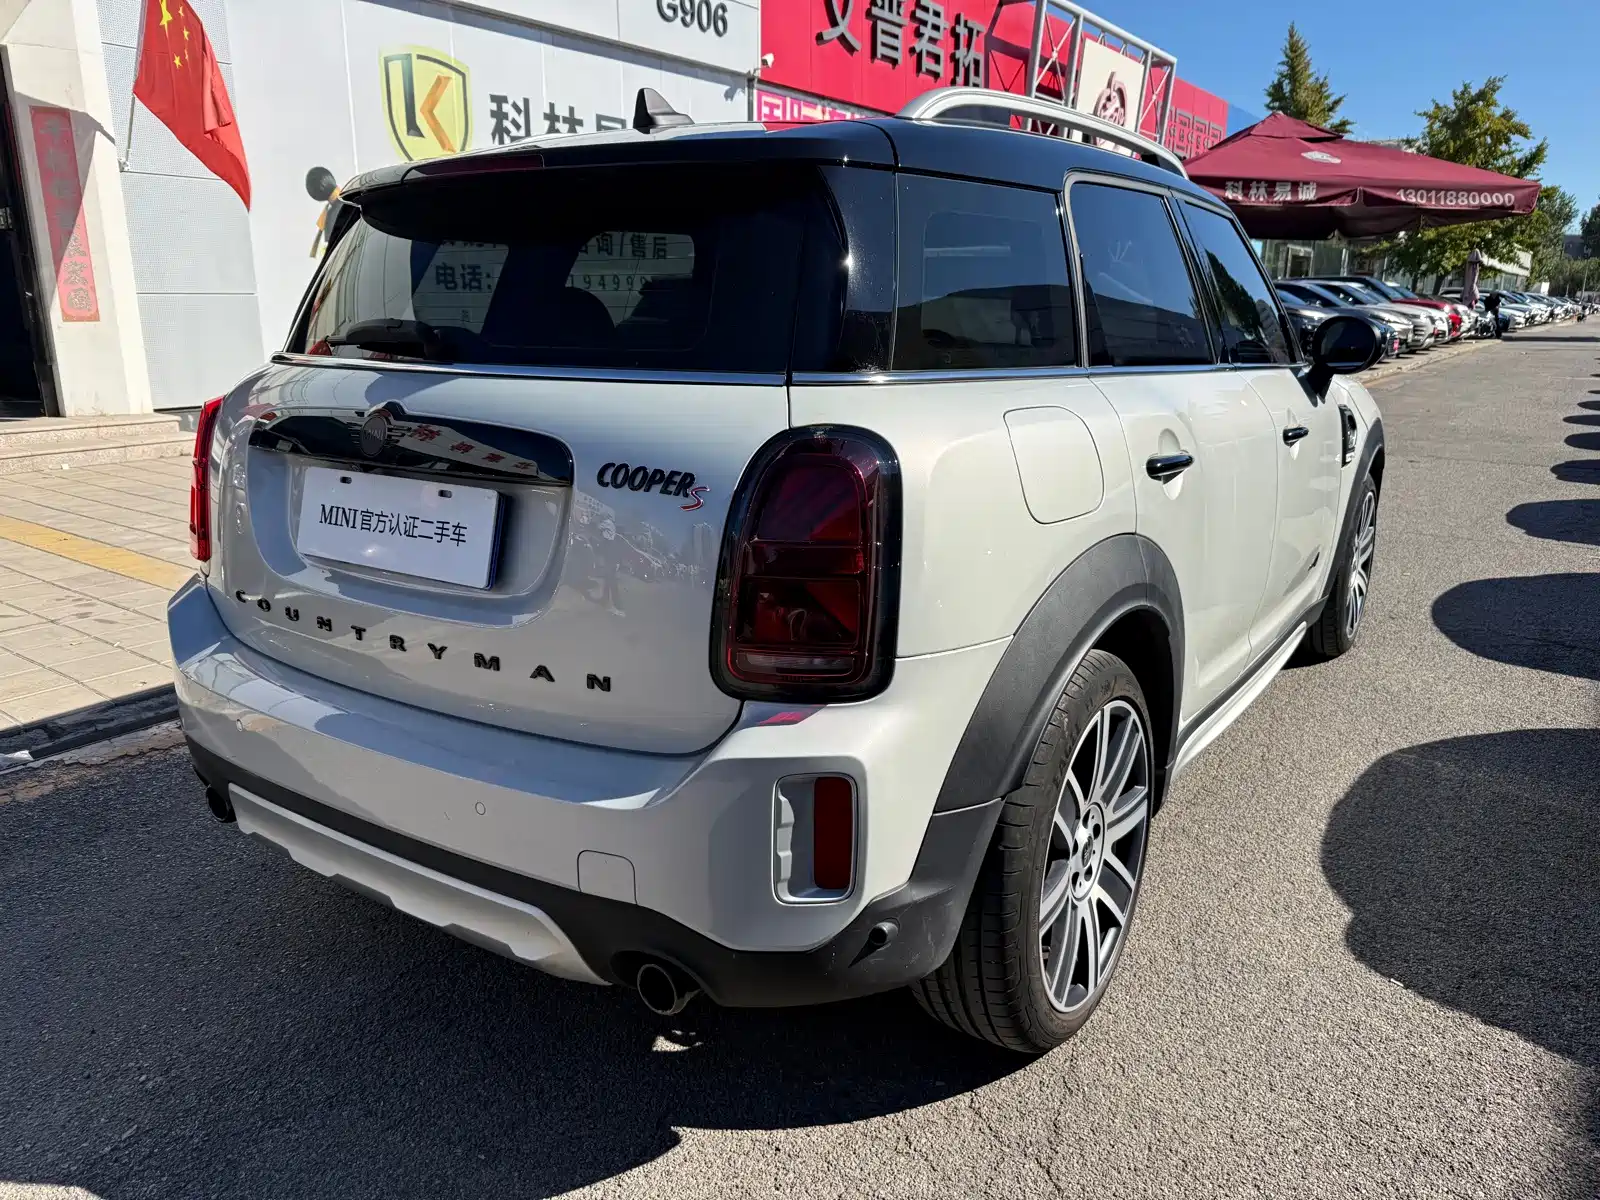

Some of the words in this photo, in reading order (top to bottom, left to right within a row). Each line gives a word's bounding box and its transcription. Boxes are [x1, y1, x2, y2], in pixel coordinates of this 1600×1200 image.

[656, 0, 729, 37] G906
[1225, 181, 1317, 201] 科林易诚
[1396, 188, 1515, 206] 13011880000
[579, 231, 668, 260] 询/售后
[597, 462, 696, 498] COOPER
[680, 486, 710, 511] S
[319, 504, 468, 547] MINI官方认证二手车
[235, 589, 611, 692] COUNTRYMAN
